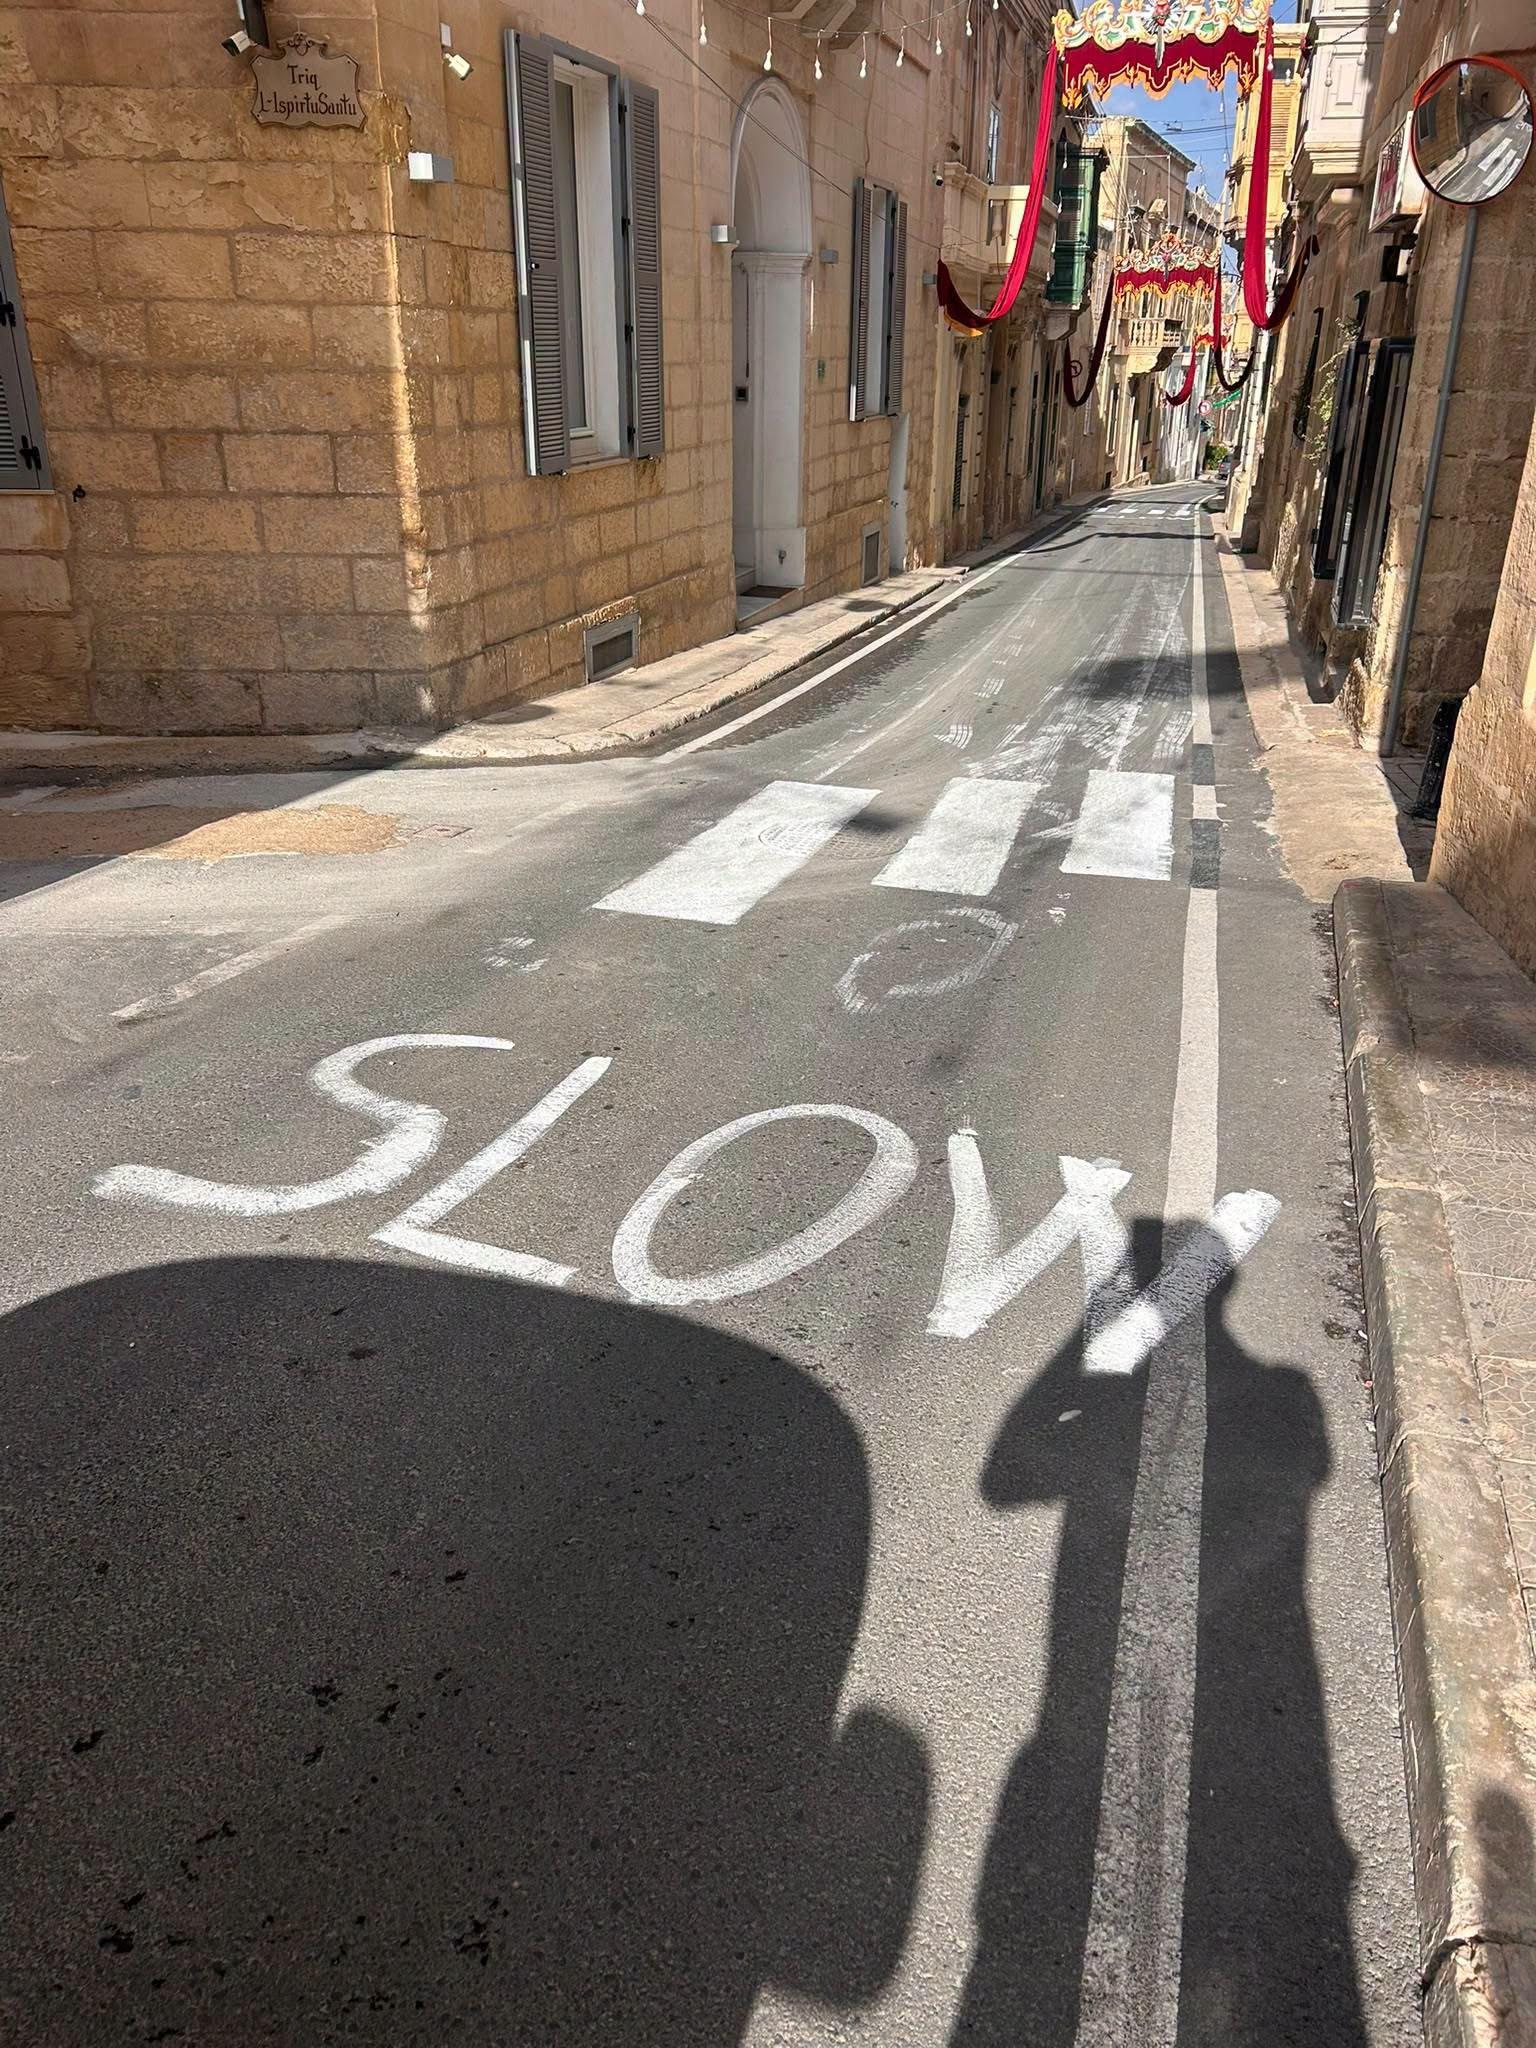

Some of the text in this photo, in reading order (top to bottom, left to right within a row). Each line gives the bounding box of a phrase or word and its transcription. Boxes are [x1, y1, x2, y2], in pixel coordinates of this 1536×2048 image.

[287, 64, 320, 91] Triq
[318, 92, 357, 115] Santu
[92, 1033, 1282, 1375] SLOW
